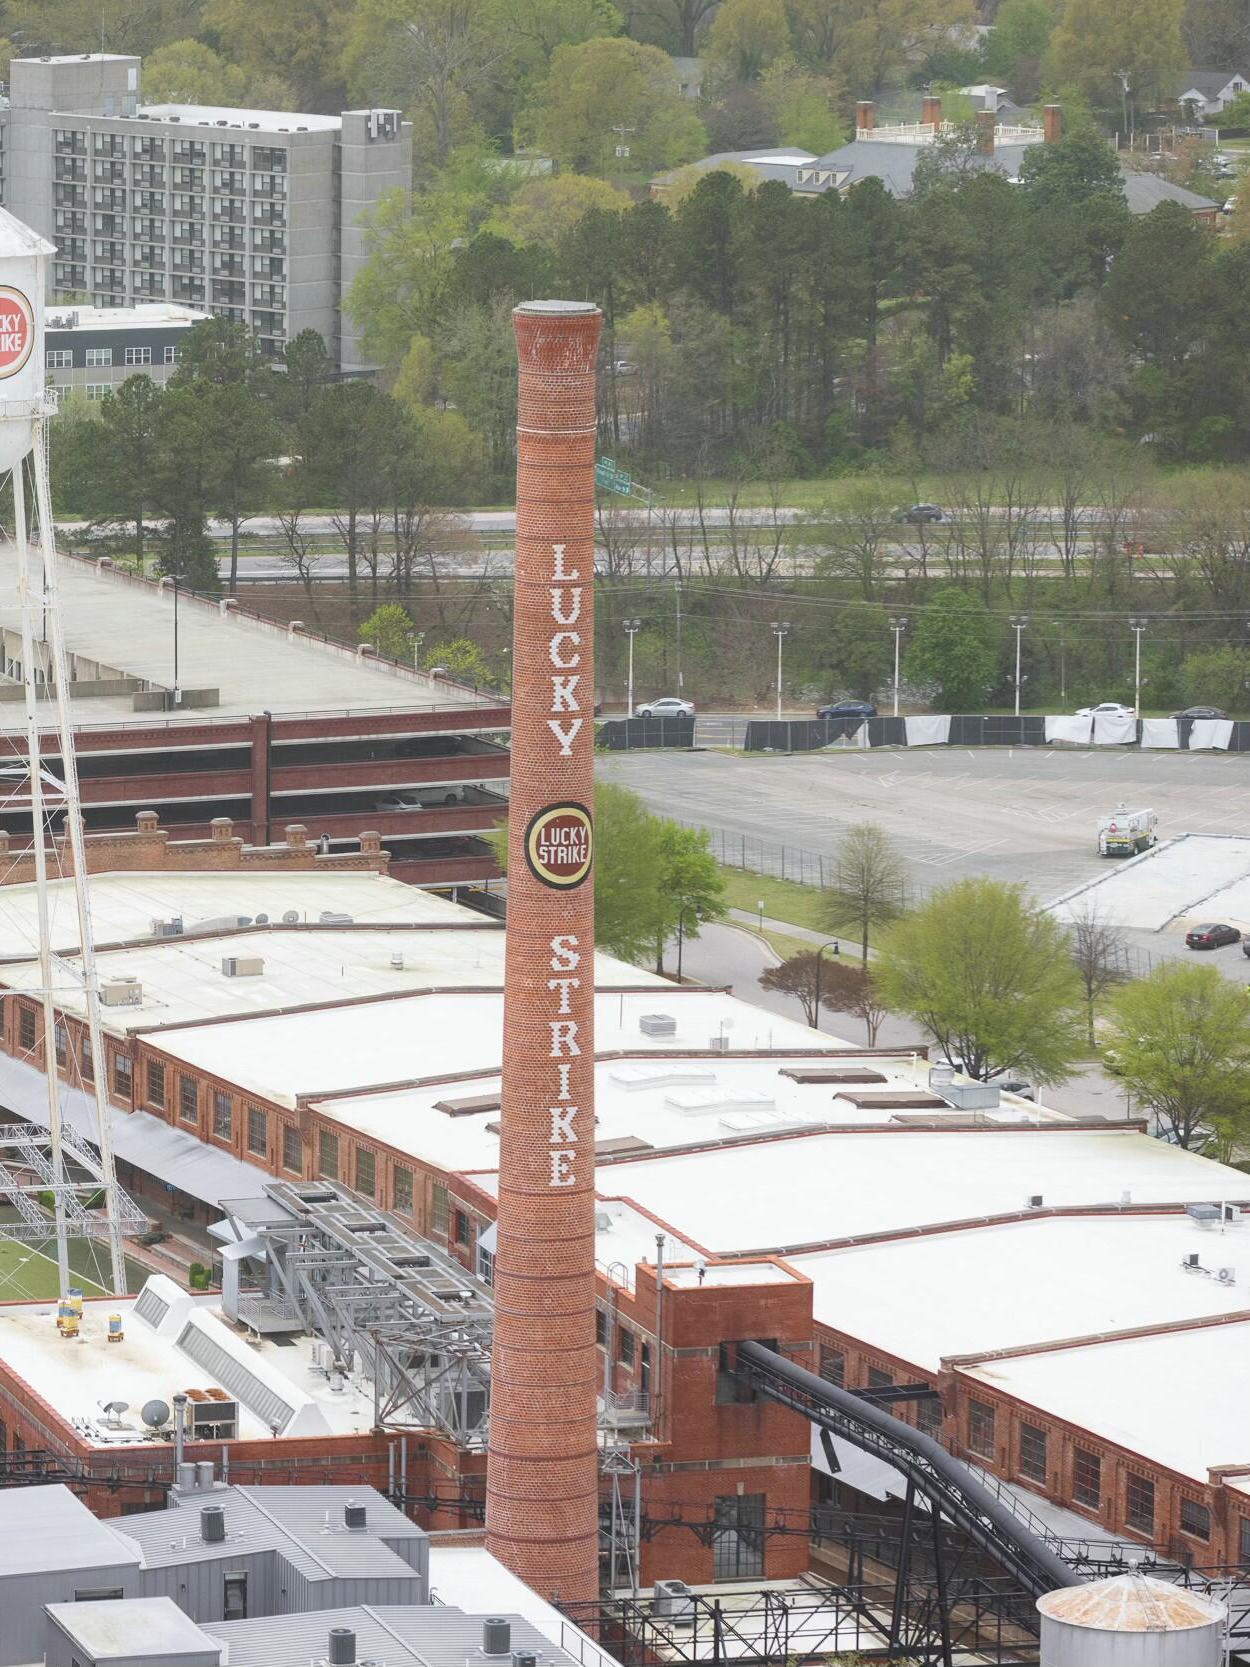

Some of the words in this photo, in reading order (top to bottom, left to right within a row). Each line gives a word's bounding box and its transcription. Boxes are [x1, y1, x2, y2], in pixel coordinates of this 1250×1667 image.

[546, 544, 583, 756] LUCKY
[539, 845, 587, 864] STRIKE
[540, 826, 587, 845] LUCKY
[547, 935, 581, 1187] STRIKE
